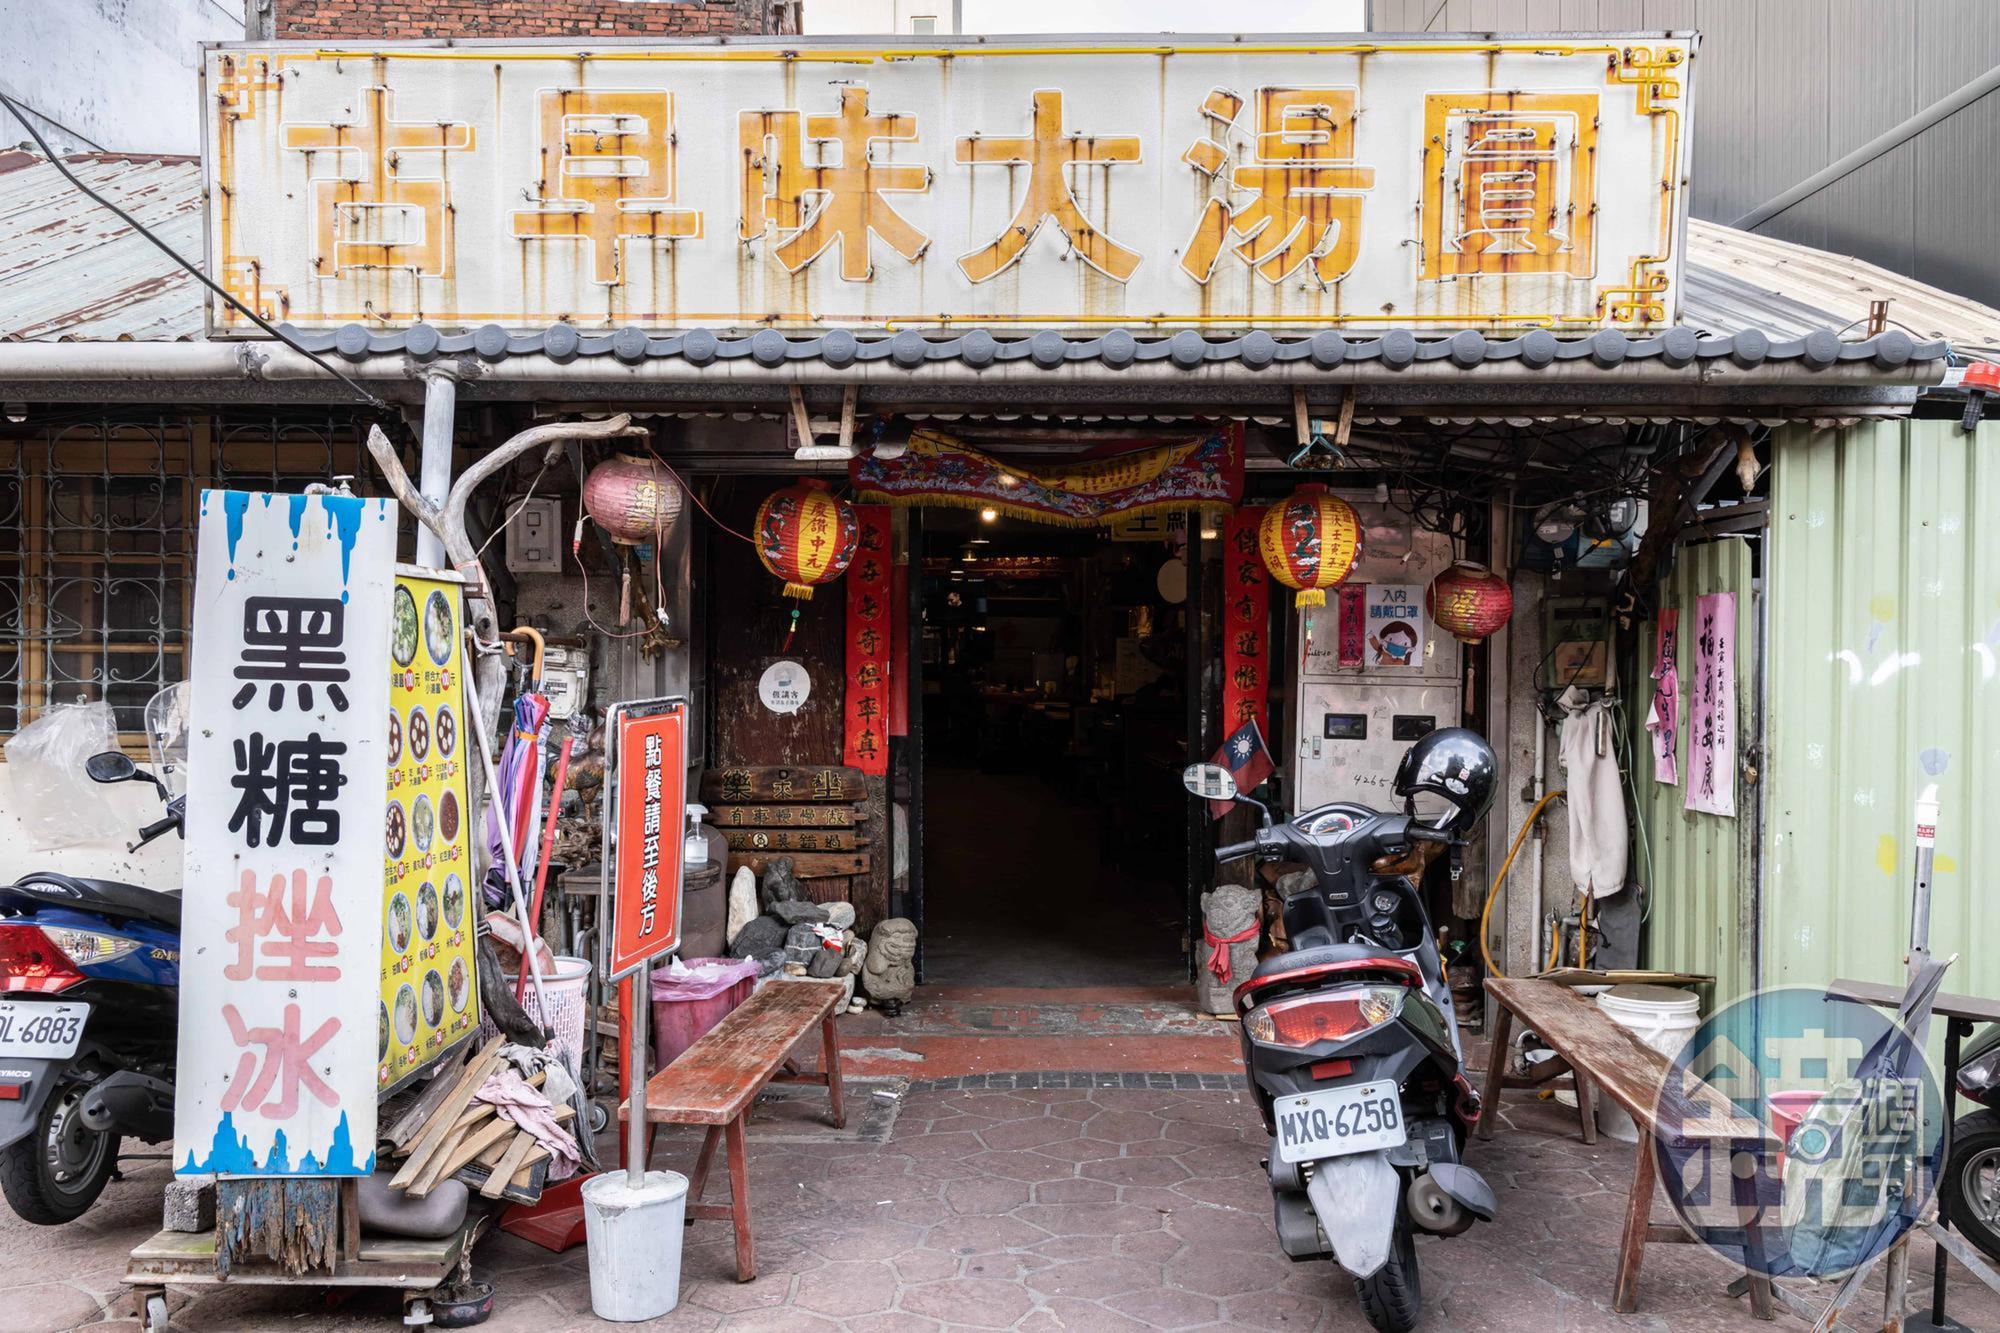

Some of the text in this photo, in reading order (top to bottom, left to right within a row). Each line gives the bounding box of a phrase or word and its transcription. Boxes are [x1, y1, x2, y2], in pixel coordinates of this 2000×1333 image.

[280, 82, 1602, 286] 古早味大湯圓
[1382, 589, 1407, 603] 入內
[1370, 604, 1419, 619] 請戴口罩
[729, 807, 849, 826] 有事慢慢做
[638, 733, 663, 938] 點餐請至後方
[0, 1069, 32, 1079] YMCO
